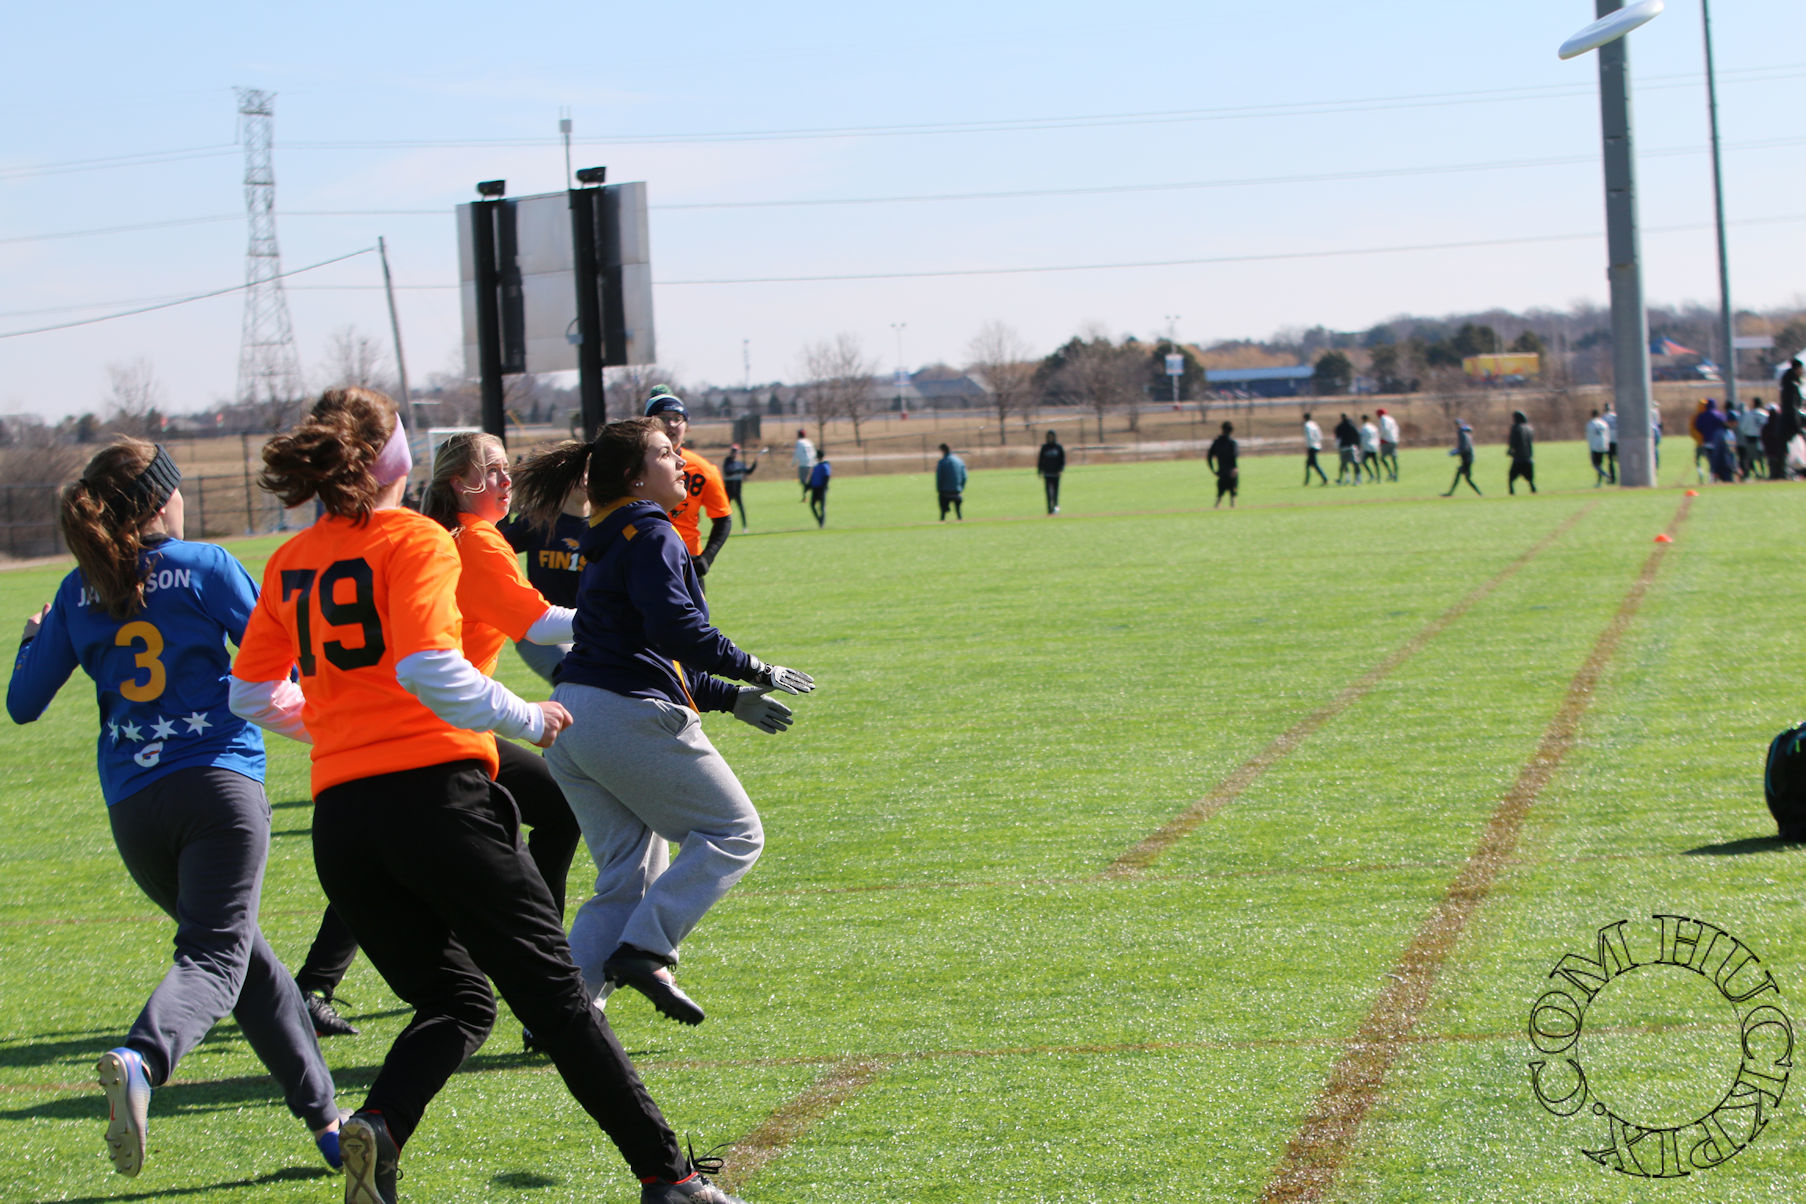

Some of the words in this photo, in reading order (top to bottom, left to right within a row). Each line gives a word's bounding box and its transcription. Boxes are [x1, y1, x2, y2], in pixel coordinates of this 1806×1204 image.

[77, 568, 191, 607] JASON
[280, 557, 386, 677] 79
[114, 620, 167, 702] 3
